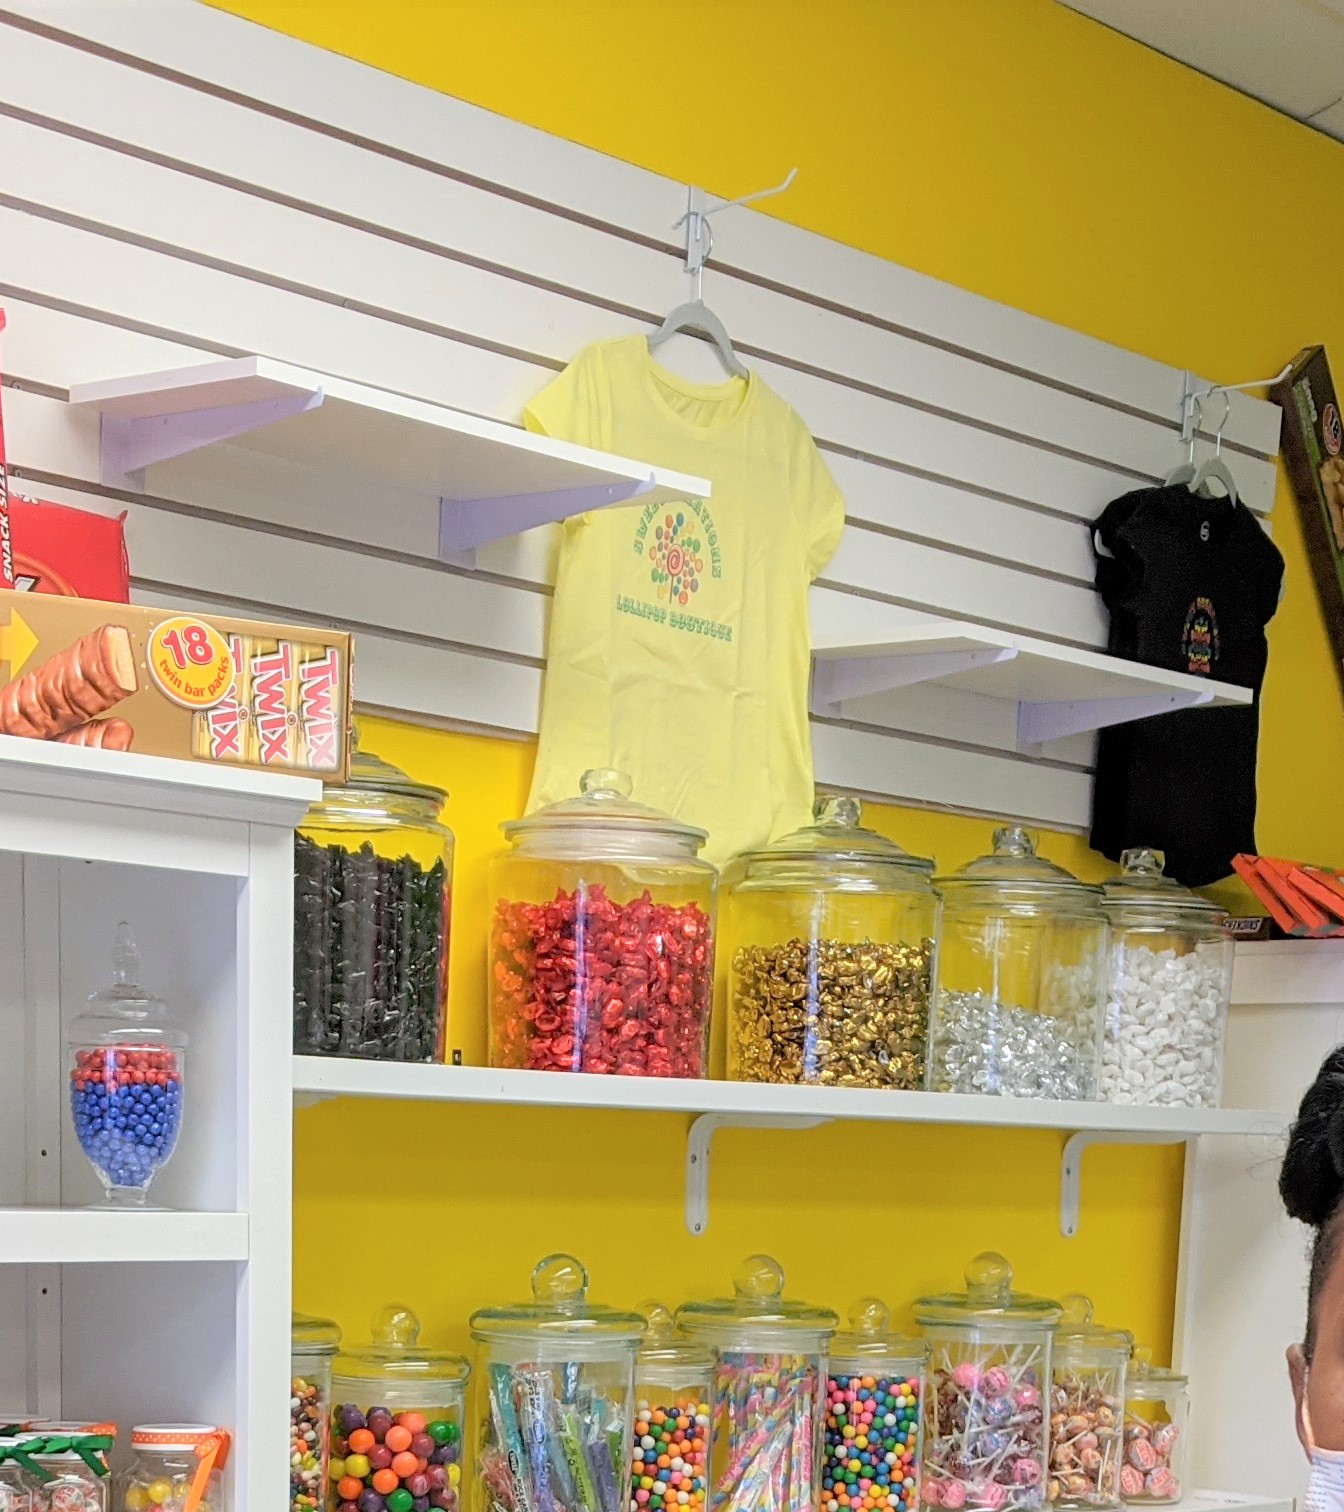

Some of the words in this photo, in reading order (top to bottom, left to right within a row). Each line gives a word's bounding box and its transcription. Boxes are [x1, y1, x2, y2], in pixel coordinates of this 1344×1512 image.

[160, 658, 183, 688] twin
[184, 683, 206, 698] bar
[207, 656, 230, 696] packs
[162, 626, 213, 669] 18
[252, 640, 293, 765] TWIX
[300, 646, 340, 767] TWIX
